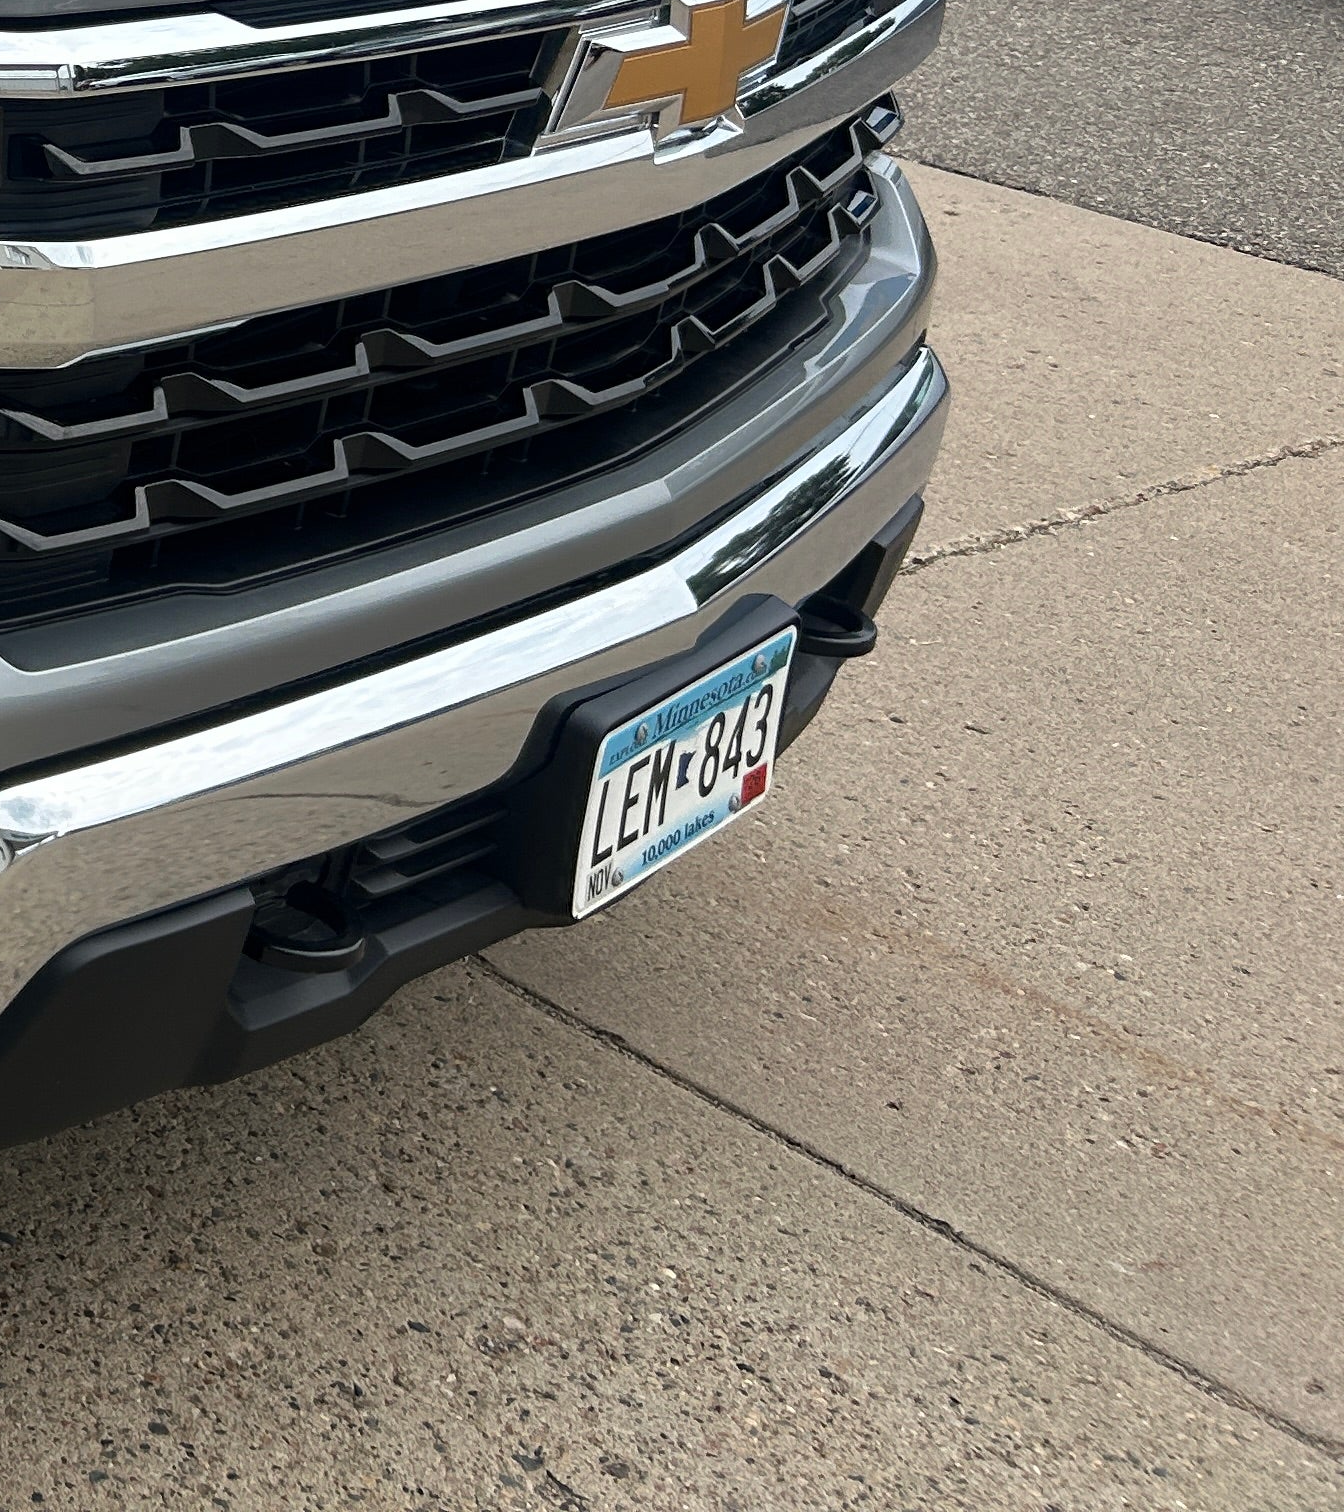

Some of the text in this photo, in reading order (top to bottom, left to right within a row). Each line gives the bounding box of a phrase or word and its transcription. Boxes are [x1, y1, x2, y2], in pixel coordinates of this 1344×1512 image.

[698, 683, 774, 798] 843
[641, 809, 716, 867] 10,000 lakes
[586, 861, 613, 902] NOV
